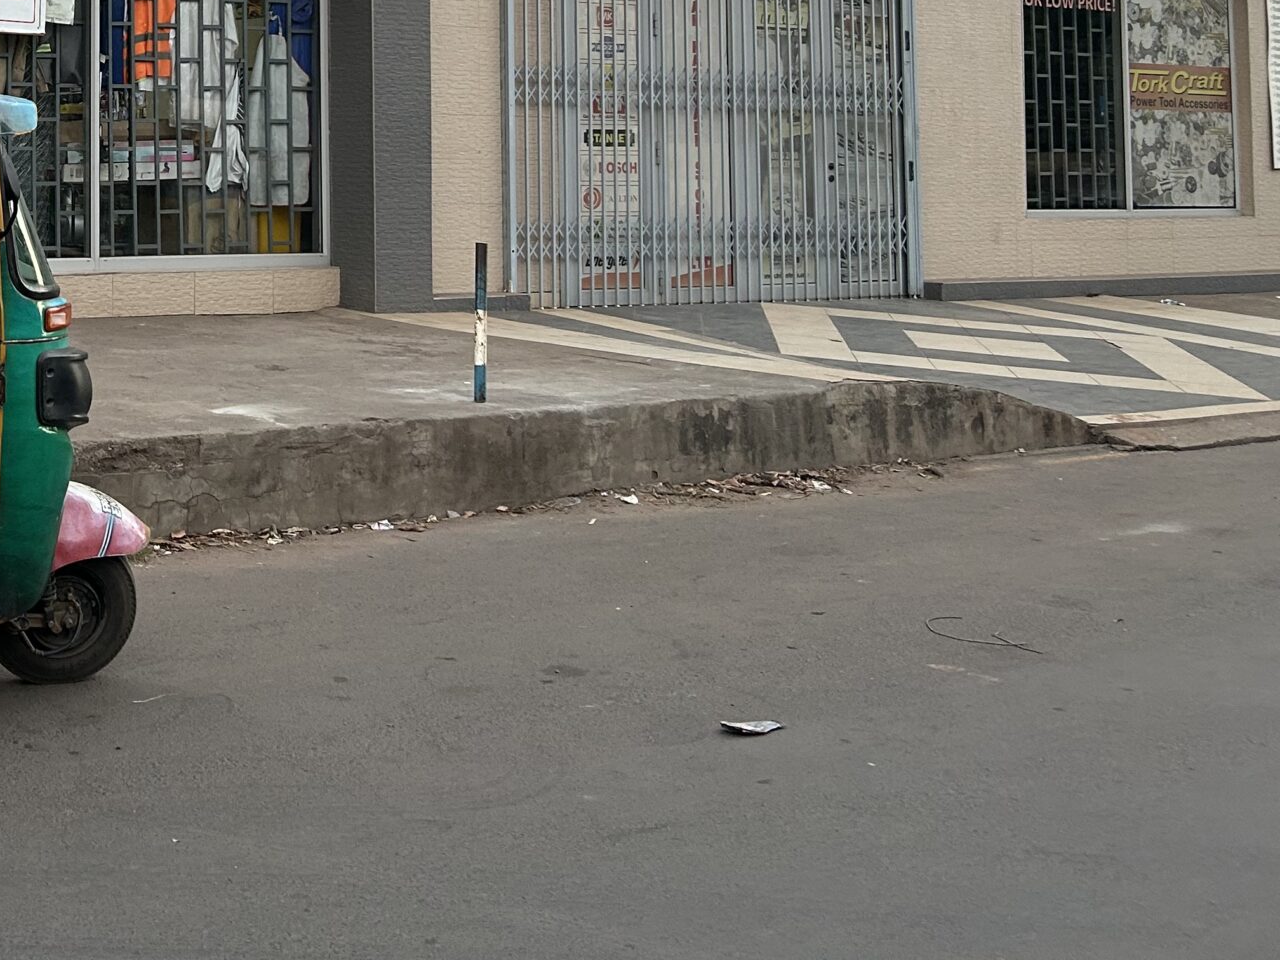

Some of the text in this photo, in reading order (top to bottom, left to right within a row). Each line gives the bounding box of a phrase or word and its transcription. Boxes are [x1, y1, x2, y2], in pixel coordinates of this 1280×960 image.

[1129, 69, 1225, 95] Tork Craft
[1130, 95, 1228, 110] Power Tool Accessories
